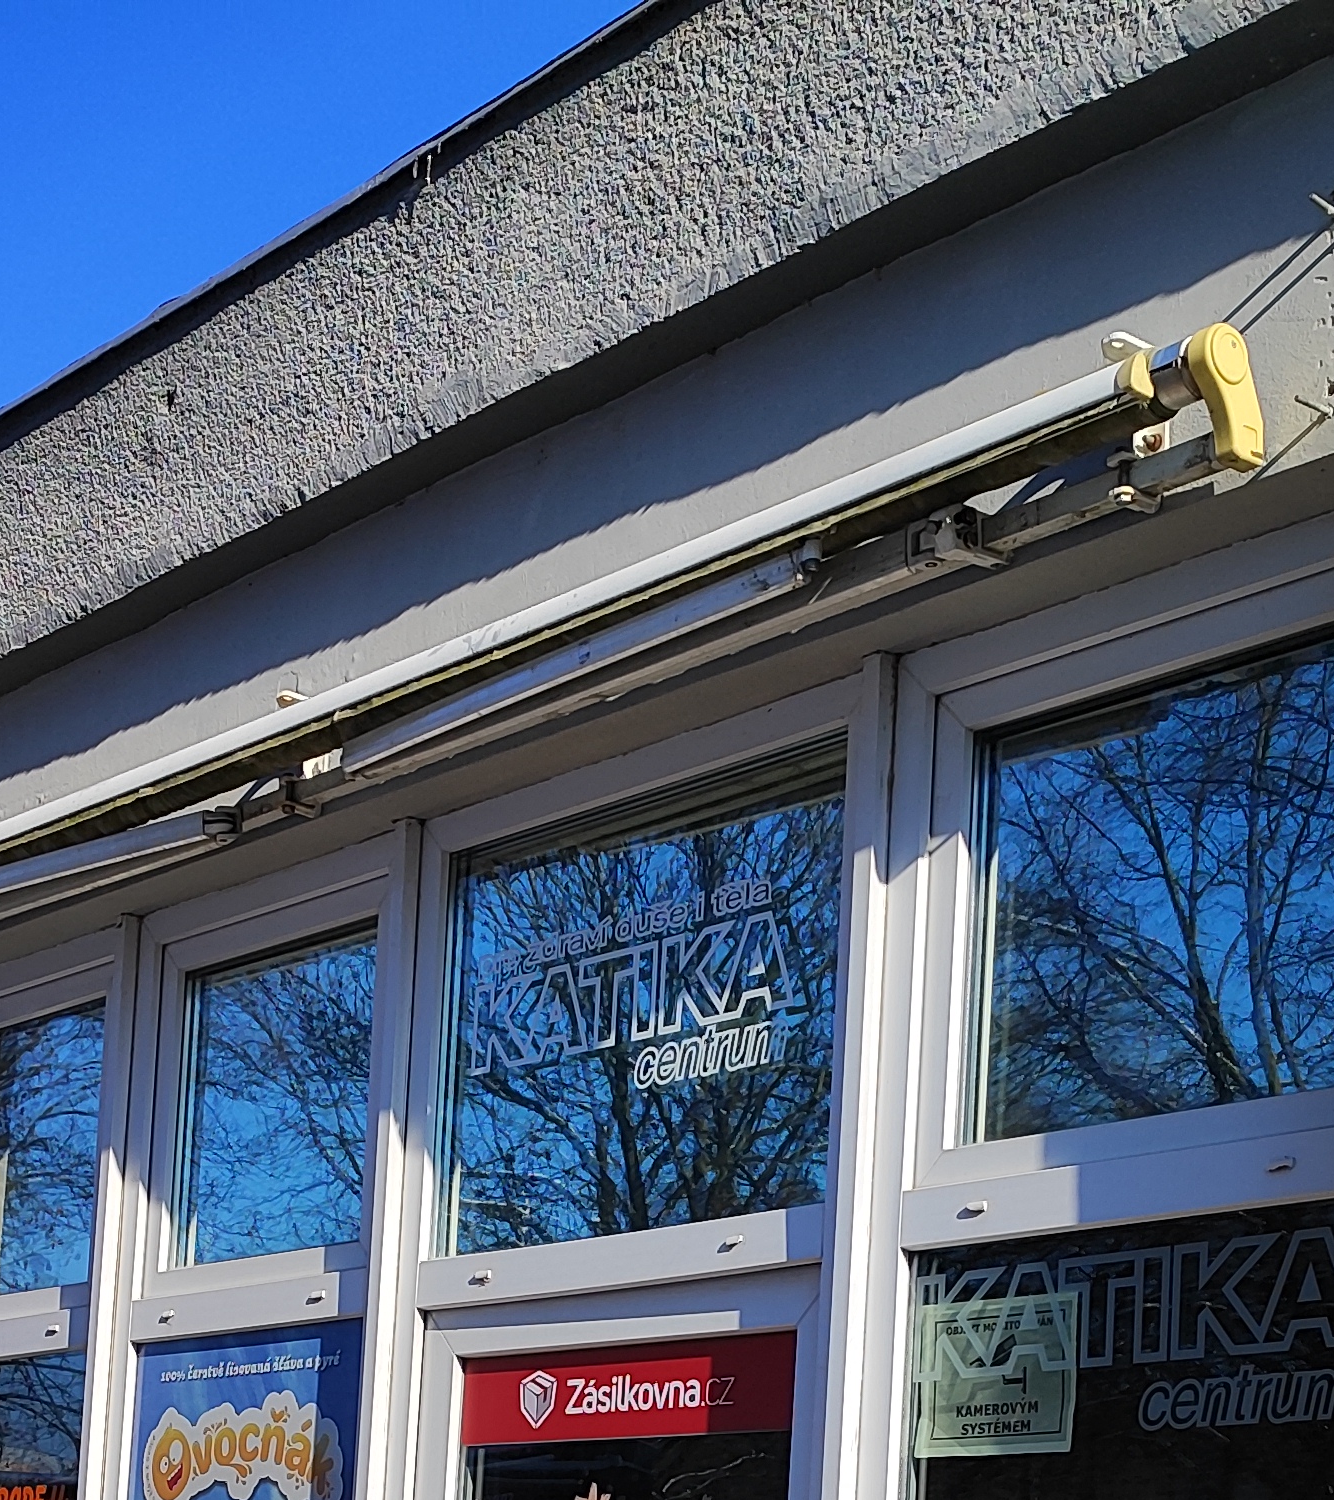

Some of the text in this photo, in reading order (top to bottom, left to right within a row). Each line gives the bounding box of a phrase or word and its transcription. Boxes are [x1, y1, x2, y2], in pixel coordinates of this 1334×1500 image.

[615, 902, 688, 943] duše
[694, 892, 705, 921] i
[710, 879, 772, 916] těla
[470, 910, 794, 1076] KATIKA
[634, 1019, 789, 1089] centrum
[305, 1360, 313, 1368] a
[956, 1397, 1039, 1418] KAMEROVÝM
[961, 1416, 1032, 1436] SYSTÉMEM
[152, 1405, 334, 1500] Ovocňák
